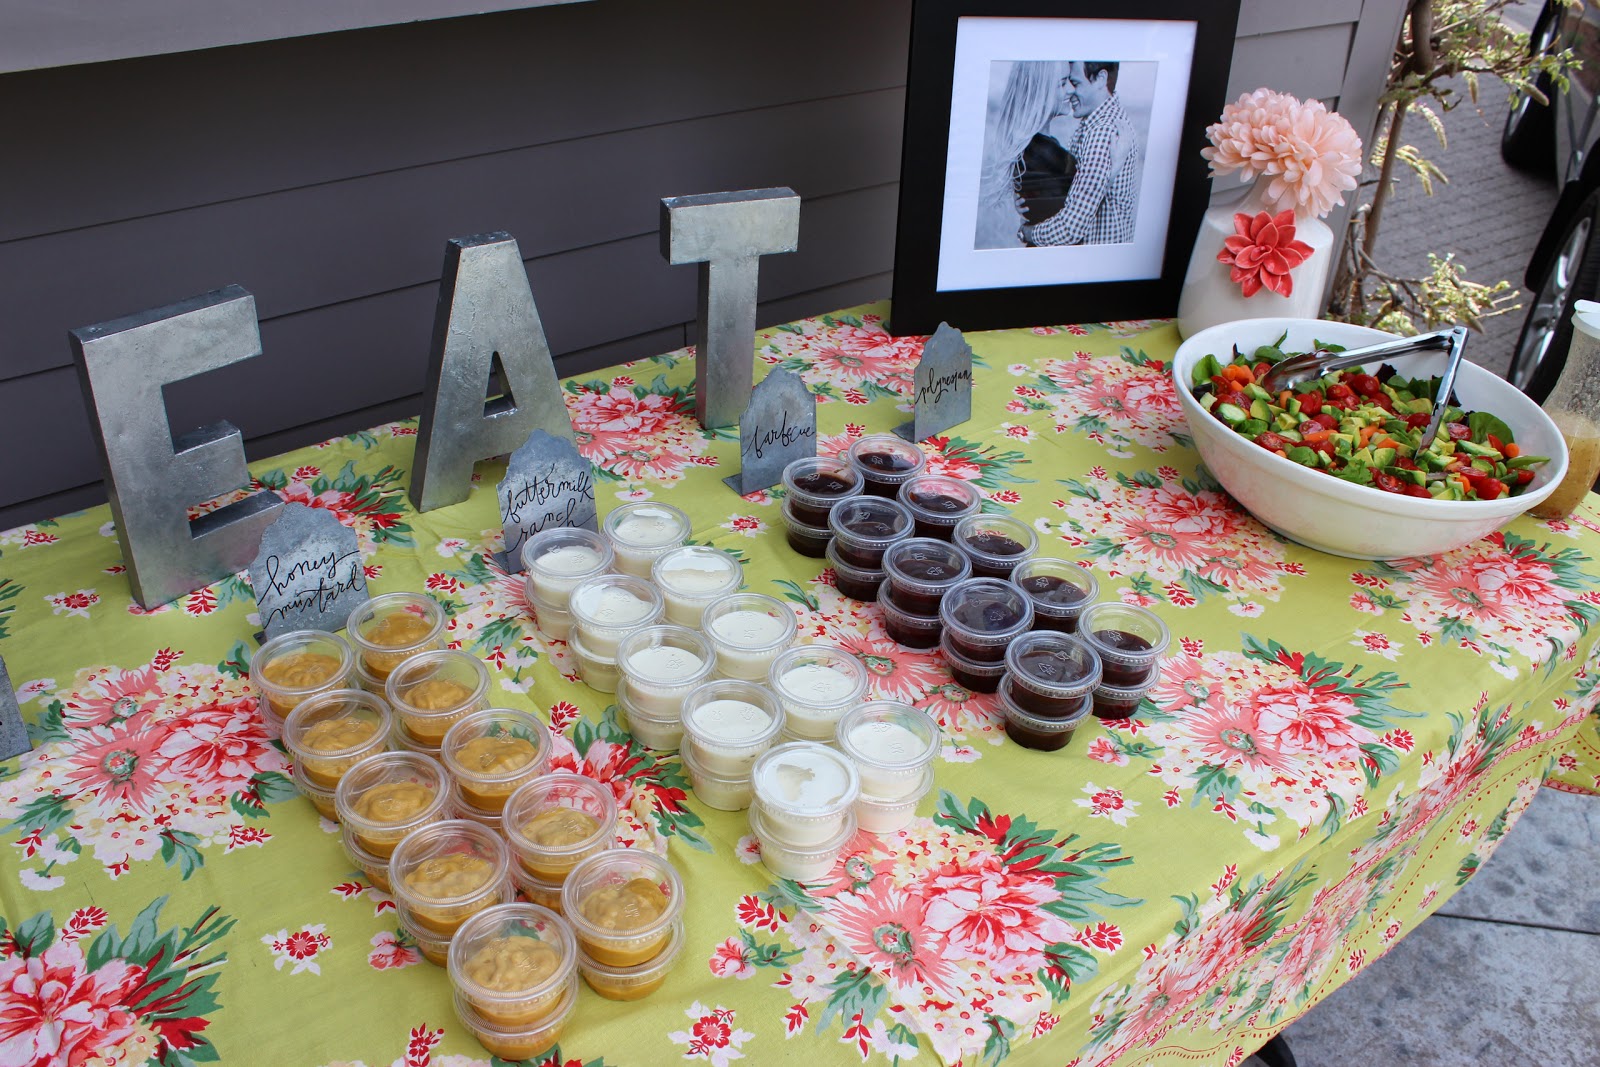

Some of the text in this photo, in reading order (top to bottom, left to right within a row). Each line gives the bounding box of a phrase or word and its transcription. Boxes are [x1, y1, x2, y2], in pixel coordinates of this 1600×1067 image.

[741, 410, 815, 459] barbecue
[502, 463, 595, 524] buttermilk
[506, 498, 597, 554] ranch
[257, 550, 360, 606] honey
[263, 564, 367, 630] mustard
